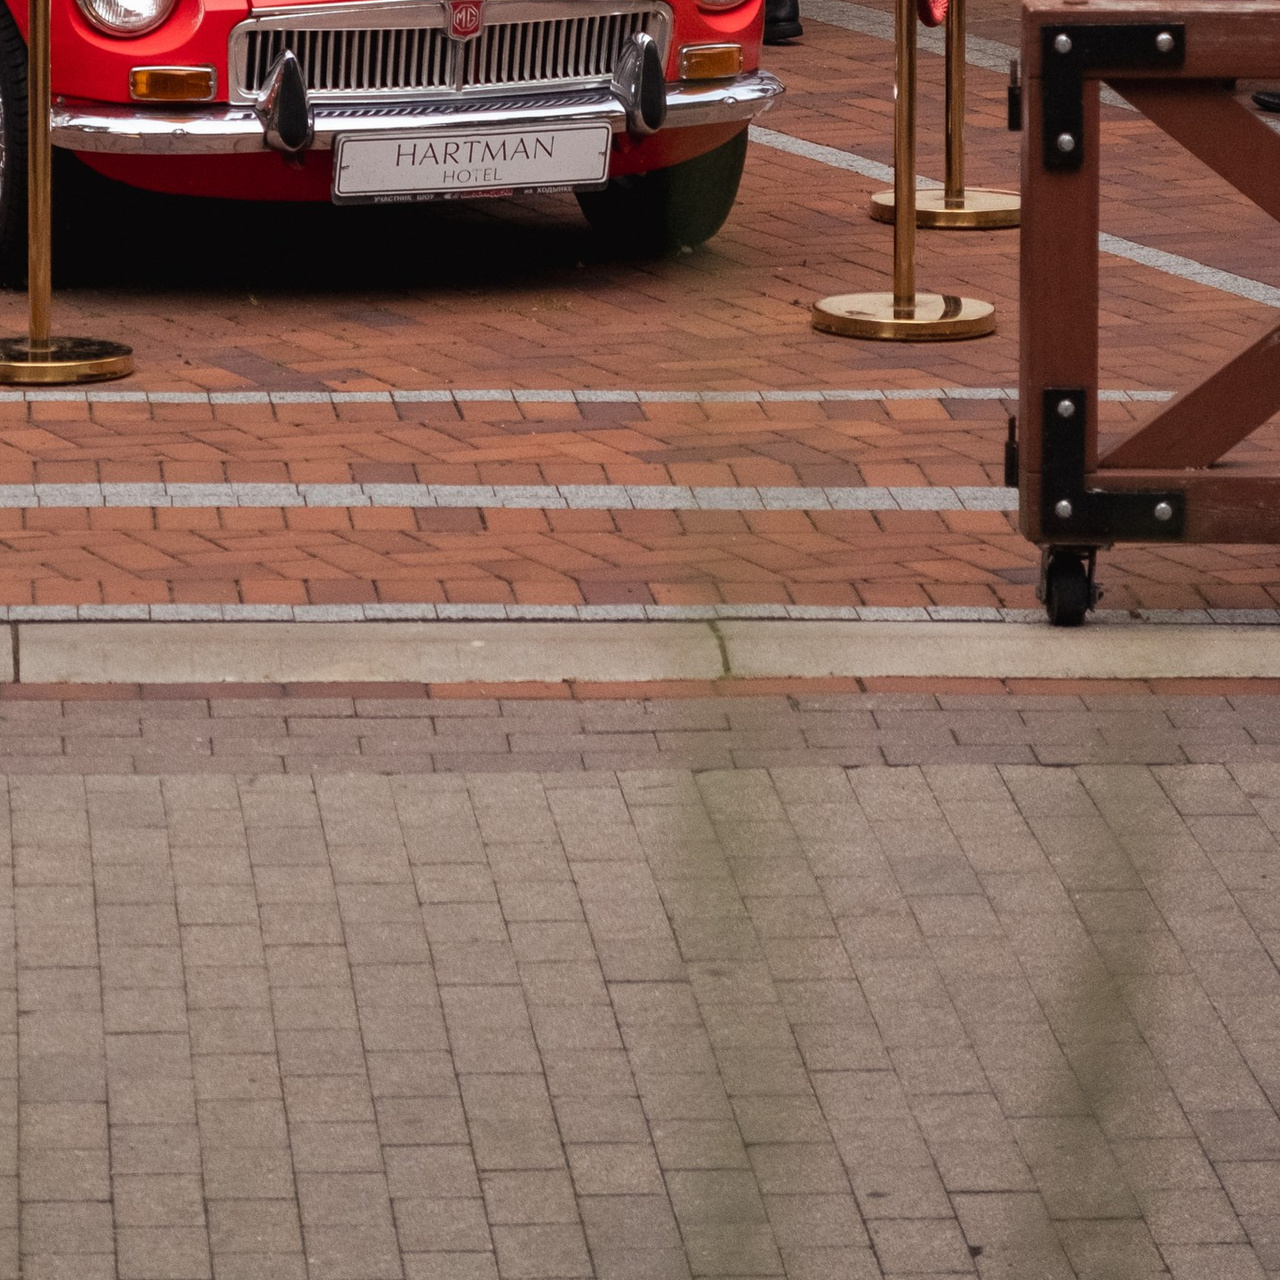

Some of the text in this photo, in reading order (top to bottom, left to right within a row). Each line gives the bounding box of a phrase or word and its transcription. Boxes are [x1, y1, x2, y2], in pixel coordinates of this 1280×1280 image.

[455, 7, 477, 28] MG
[395, 136, 556, 167] HARTMAN
[442, 167, 503, 184] HOTEL
[374, 194, 413, 202] УЧАСТНИК
[416, 193, 435, 201] ШОУ
[536, 185, 573, 194] ХОДЫНКЕ
